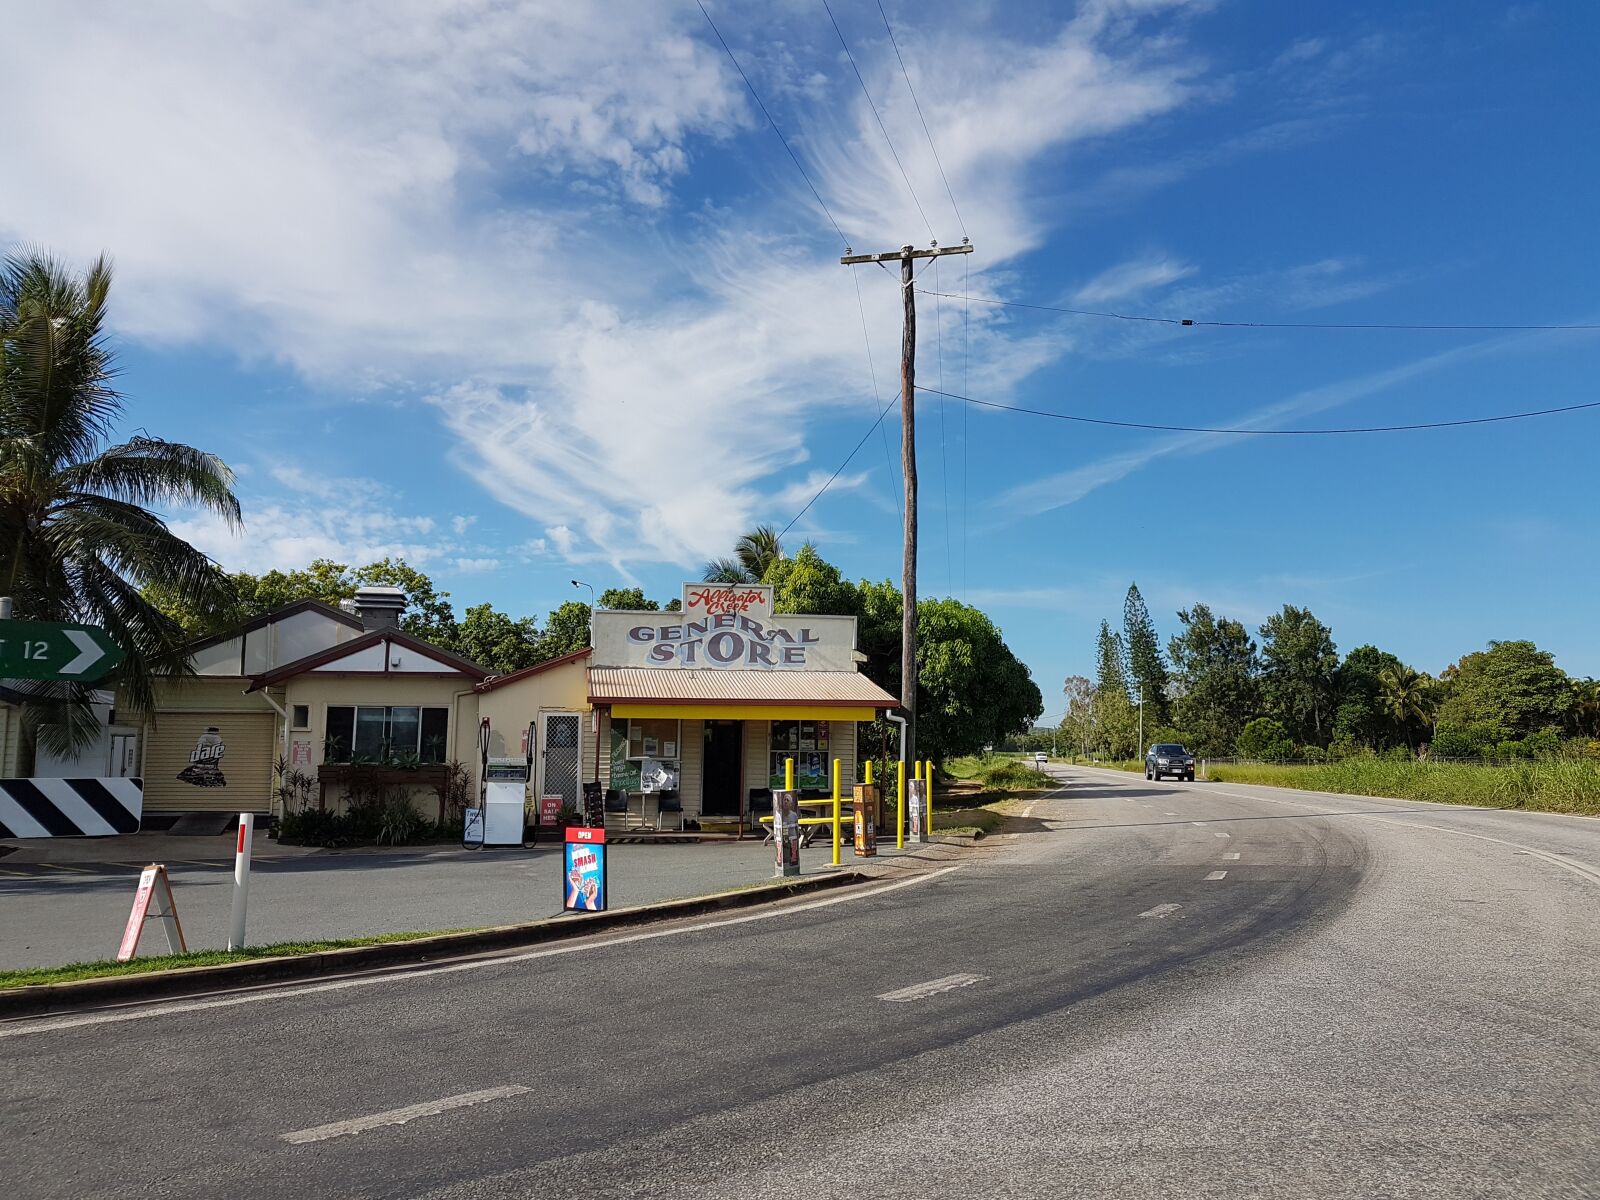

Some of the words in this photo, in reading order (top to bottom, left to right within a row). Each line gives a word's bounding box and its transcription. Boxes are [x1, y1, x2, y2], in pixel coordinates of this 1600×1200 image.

[687, 588, 766, 608] Alligator
[706, 601, 749, 616] Creek
[628, 613, 820, 643] GENERAL
[23, 641, 49, 660] 12
[650, 631, 807, 665] STORE
[577, 831, 592, 839] OPEN
[573, 853, 597, 868] SMASH
